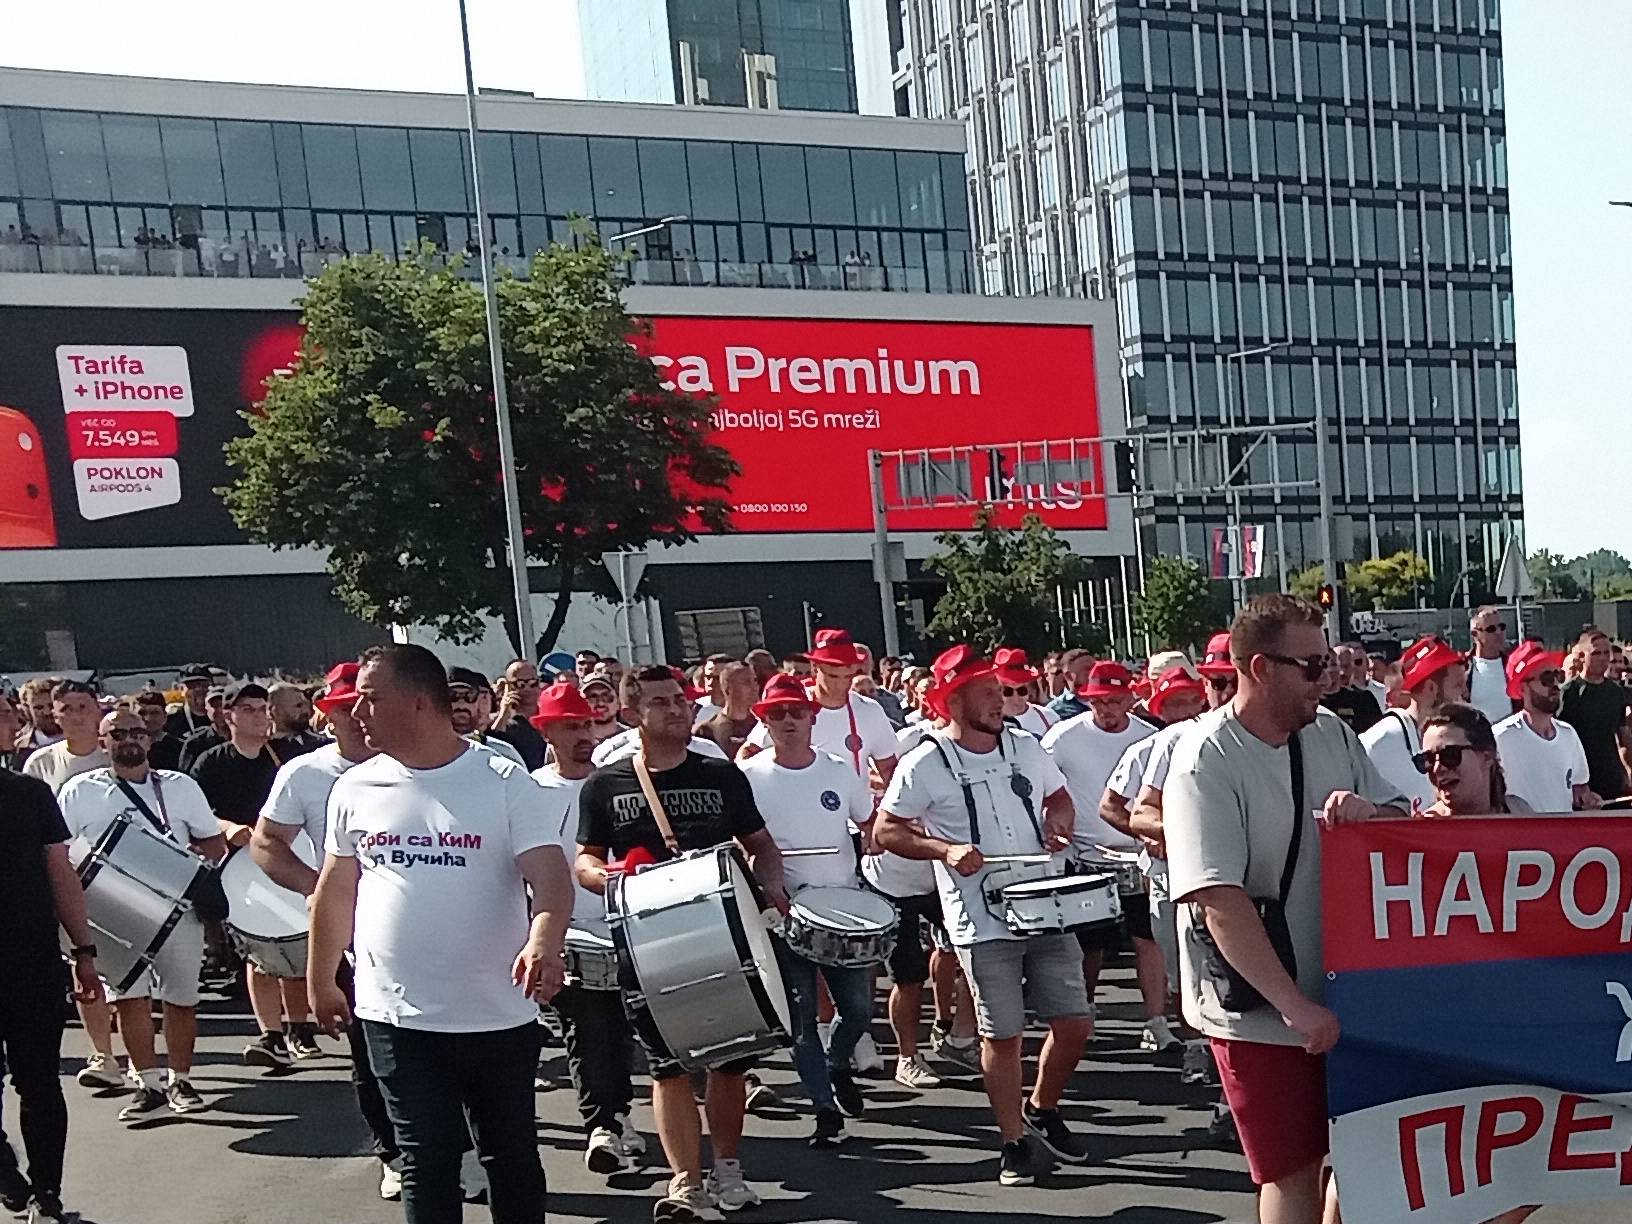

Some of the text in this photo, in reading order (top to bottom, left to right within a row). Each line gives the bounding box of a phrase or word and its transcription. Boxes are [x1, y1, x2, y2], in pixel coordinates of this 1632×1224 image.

[67, 355, 144, 375] Tarifa
[725, 346, 981, 395] Premium
[94, 381, 183, 400] iPhone
[789, 409, 818, 429] 5G
[824, 409, 881, 429] mreži
[81, 430, 141, 447] 7.549
[87, 466, 163, 480] POKLON
[89, 484, 142, 493] AIRPODS
[740, 503, 769, 513] 0800
[770, 503, 789, 513] 100
[617, 791, 722, 822] NO CUSES
[407, 835, 433, 847] са
[438, 831, 482, 850] КиМ
[391, 850, 467, 868] Вучића
